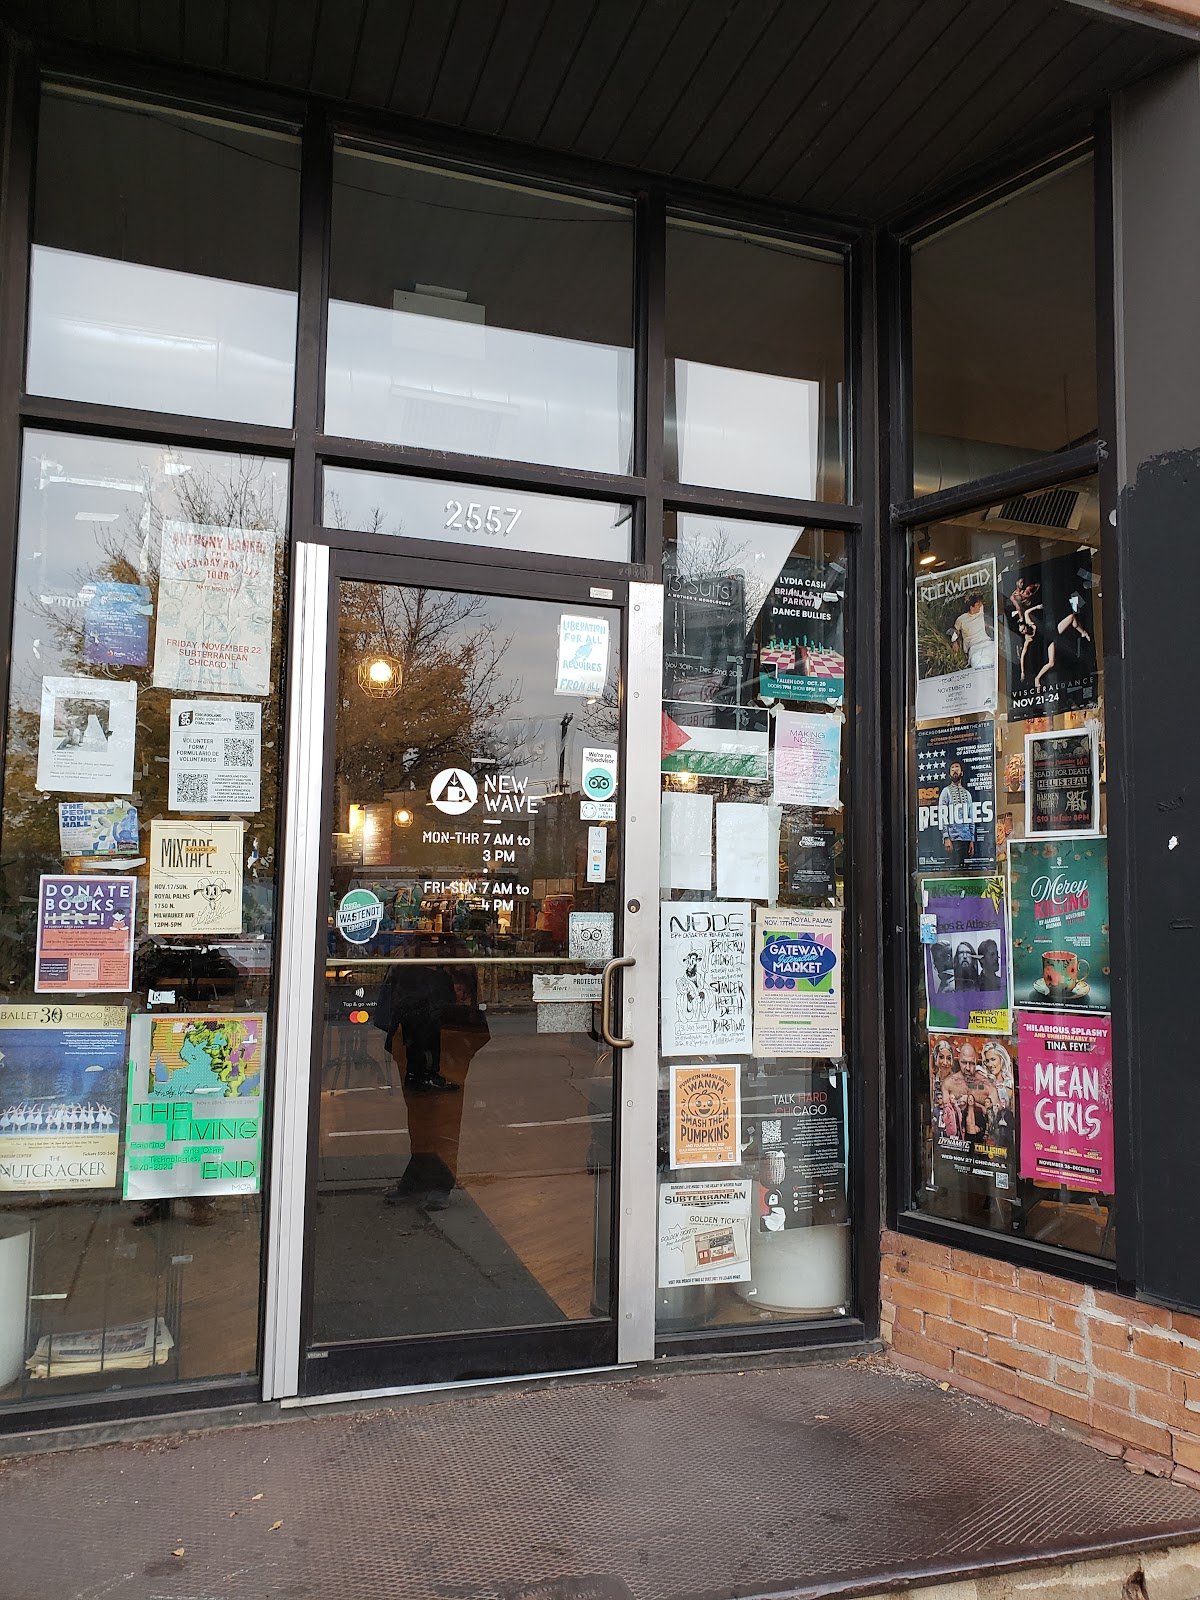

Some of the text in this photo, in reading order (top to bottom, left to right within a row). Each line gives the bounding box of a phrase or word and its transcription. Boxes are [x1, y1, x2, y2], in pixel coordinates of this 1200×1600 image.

[446, 500, 522, 535] 2557
[207, 570, 229, 581] TOUR
[667, 573, 729, 600] 13 Suits
[779, 577, 826, 589] LYDIA CASH
[920, 568, 991, 603] ROCKWOOD
[773, 607, 831, 621] DANCE BULLIES
[563, 620, 606, 635] LIBERATION
[564, 633, 602, 645] FOR ALL
[179, 648, 248, 662] SUBTERRANEAN
[202, 642, 249, 654] NOVEMBER
[251, 646, 262, 655] 22
[231, 661, 239, 670] IL
[562, 659, 602, 672] REQUIRES
[699, 665, 711, 673] Dec
[560, 678, 600, 692] FROM ALL
[1013, 693, 1060, 710] NOV 21-24
[1033, 770, 1055, 778] READY
[1068, 767, 1091, 775] DEATH
[484, 774, 528, 794] NEW
[1038, 779, 1055, 787] HELL
[1066, 777, 1087, 785] REAL
[918, 786, 940, 800] RSC
[484, 793, 539, 814] WAVE
[919, 801, 994, 832] PERICLES
[422, 831, 531, 846] MON-THR 7 AM to
[161, 838, 213, 868] MIXTAPE
[482, 850, 515, 862] 3 PM
[46, 885, 130, 898] DONATE
[423, 881, 530, 895] FRI-SUN 7 AM to
[1031, 873, 1088, 905] Mercy
[45, 899, 114, 911] BOOKS
[481, 899, 514, 912] 4 PM
[1034, 889, 1090, 919] KILLING
[44, 912, 105, 925] HERE!
[339, 906, 380, 924] WASTENOT
[791, 916, 811, 924] ROYAL
[937, 919, 998, 932] aps & Atlases
[769, 944, 826, 956] GATEWAY
[772, 962, 822, 973] MARKET
[1, 1011, 38, 1020] BALLET
[65, 1011, 103, 1019] CHICAGO
[968, 1016, 998, 1024] METRO
[1071, 1026, 1108, 1038] SPLASHY
[1046, 1041, 1067, 1050] TINA
[679, 1074, 701, 1089] PUMPKIN
[688, 1079, 724, 1094] WANNA
[1034, 1062, 1099, 1102] MEAN
[772, 1091, 828, 1105] TALK HARD
[133, 1102, 189, 1121] THE
[680, 1107, 729, 1127] SMASH THEM
[775, 1104, 828, 1118] CHICAGO
[1034, 1097, 1102, 1140] GIRLS
[171, 1121, 257, 1141] LIVING
[681, 1123, 729, 1143] PUMPKINS
[130, 1142, 166, 1150] Painting
[202, 1146, 224, 1154] Other
[937, 1137, 1008, 1157] DYNAMITE COLLISION
[0, 1162, 106, 1179] NUTCRACKER
[203, 1161, 255, 1179] END
[1039, 1160, 1064, 1168] NOVEMBER
[664, 1191, 746, 1205] SUBTERRANEAN
[689, 1215, 718, 1224] GOLDEN
